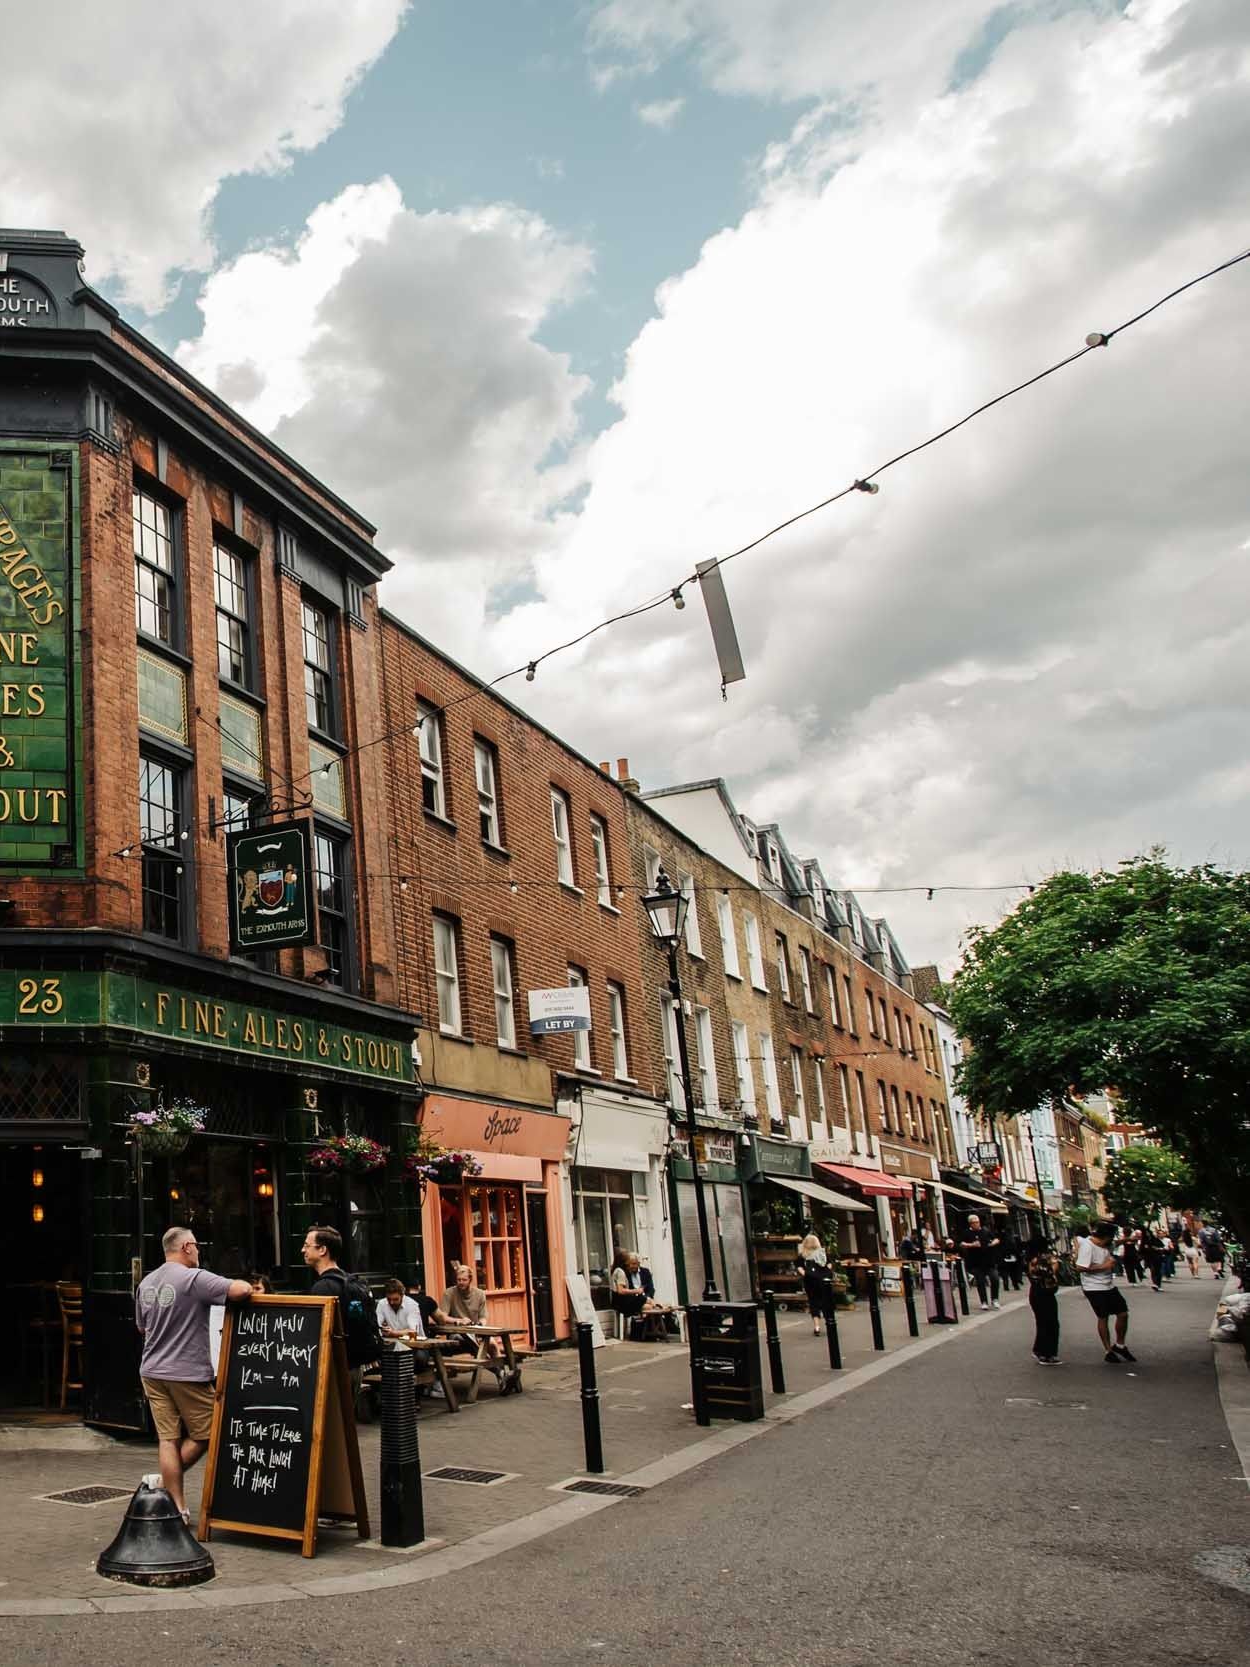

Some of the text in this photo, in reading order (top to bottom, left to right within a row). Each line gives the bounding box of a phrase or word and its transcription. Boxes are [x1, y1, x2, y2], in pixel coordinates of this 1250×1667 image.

[240, 926, 254, 936] THE
[256, 921, 287, 934] EXMOUTH
[19, 978, 63, 1014] 23
[156, 992, 228, 1039] FINE
[244, 1012, 303, 1052] ALES
[318, 1028, 329, 1057] &
[545, 1019, 575, 1029] LET BY
[484, 1110, 522, 1144] Space
[237, 1312, 268, 1341] LUNCH
[237, 1341, 275, 1362] EVERY
[246, 1421, 268, 1441] TIME
[229, 1443, 292, 1470] THE PACK LUNCH
[232, 1464, 249, 1489] AT
